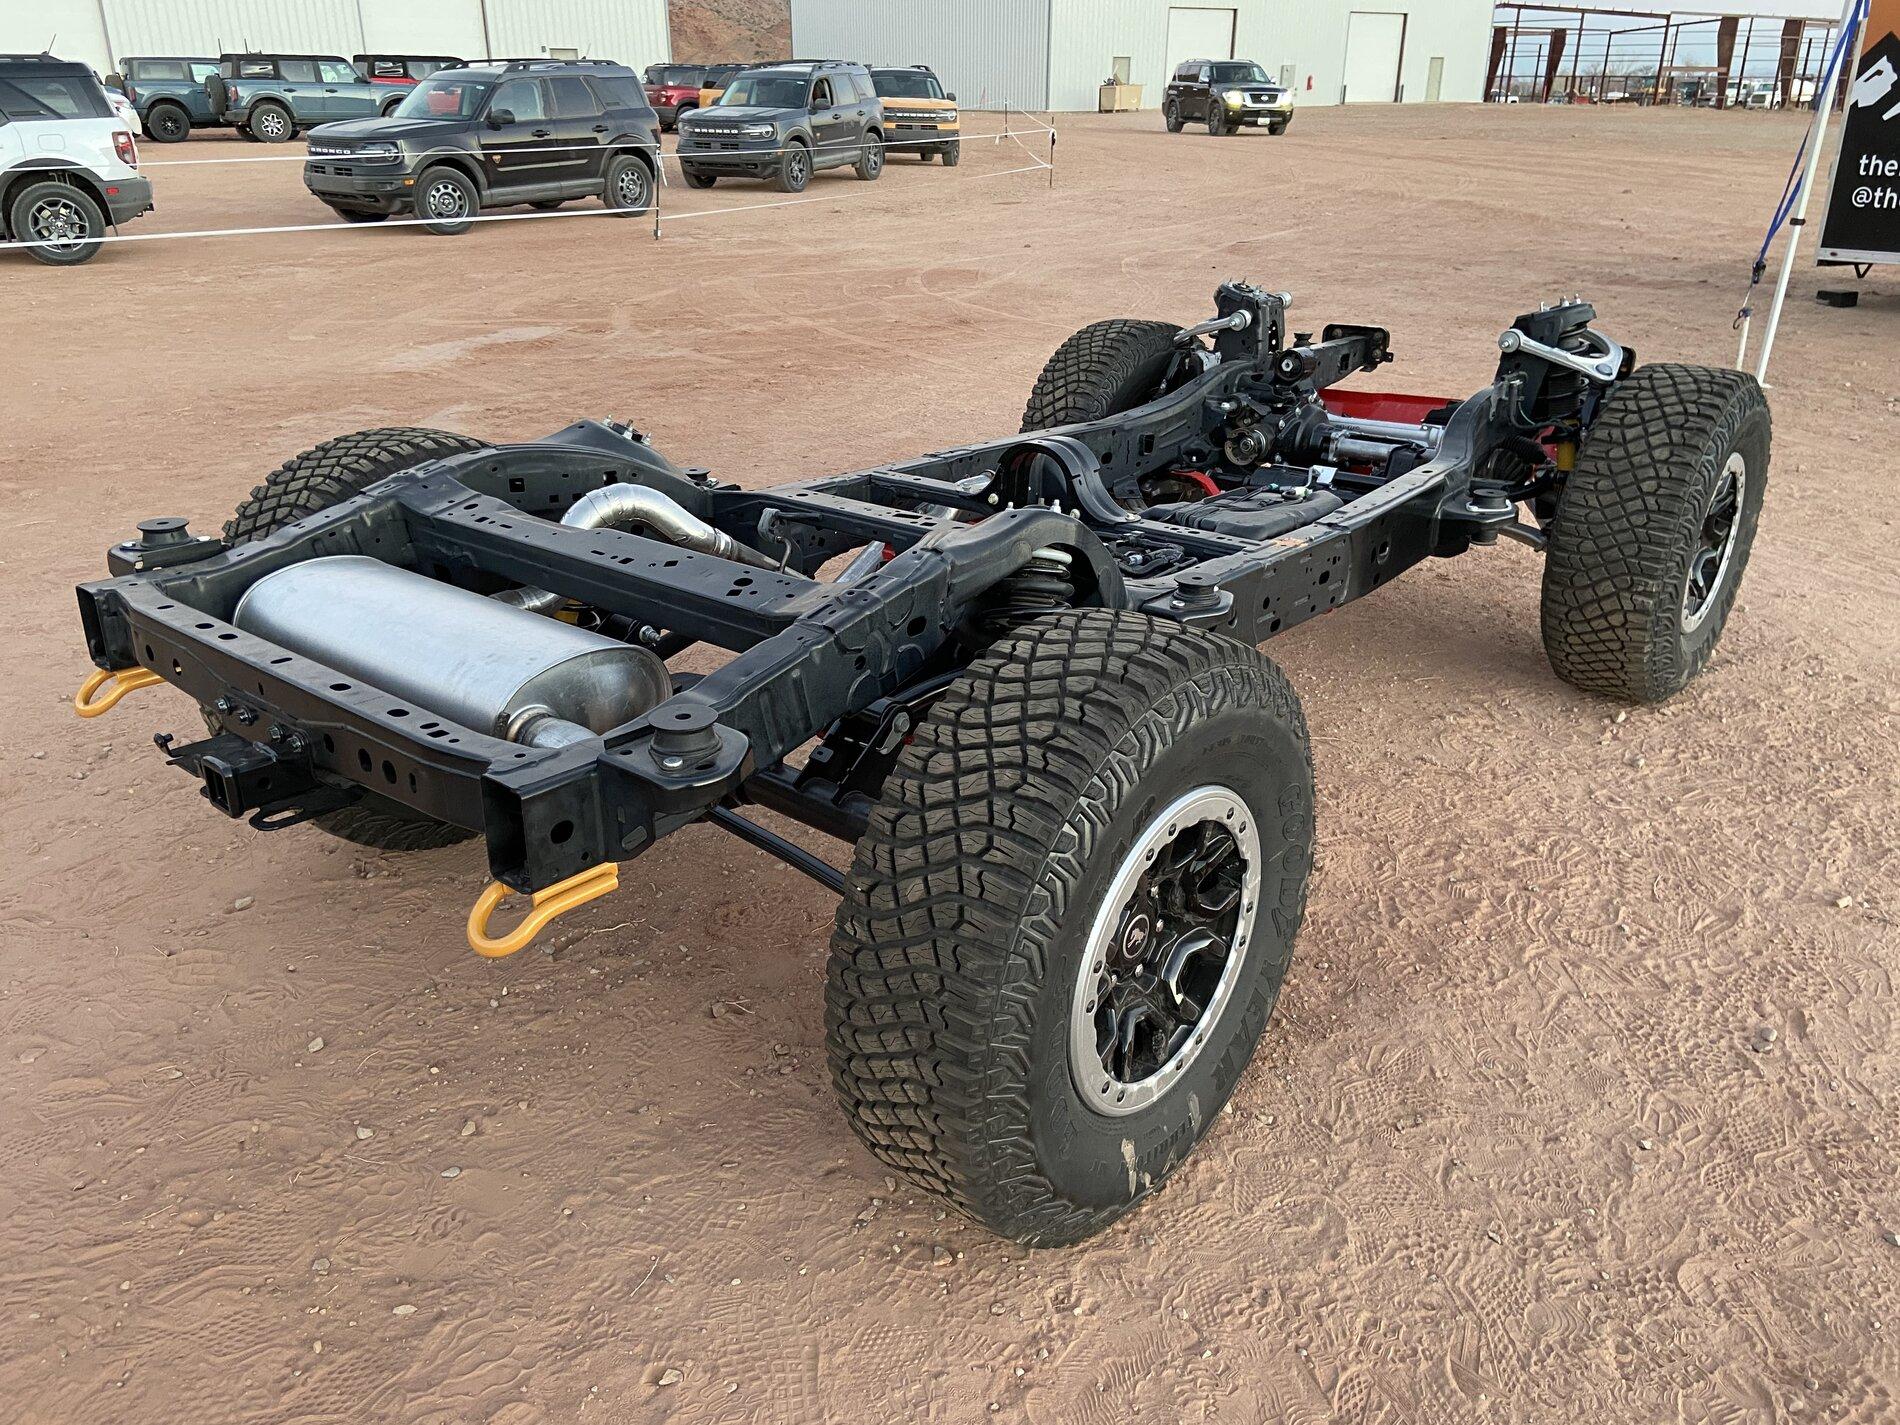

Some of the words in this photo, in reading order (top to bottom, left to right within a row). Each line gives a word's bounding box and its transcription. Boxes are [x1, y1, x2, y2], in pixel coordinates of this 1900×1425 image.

[310, 147, 351, 155] BRONCO
[1859, 154, 1900, 177] the
[1851, 186, 1900, 209] @th
